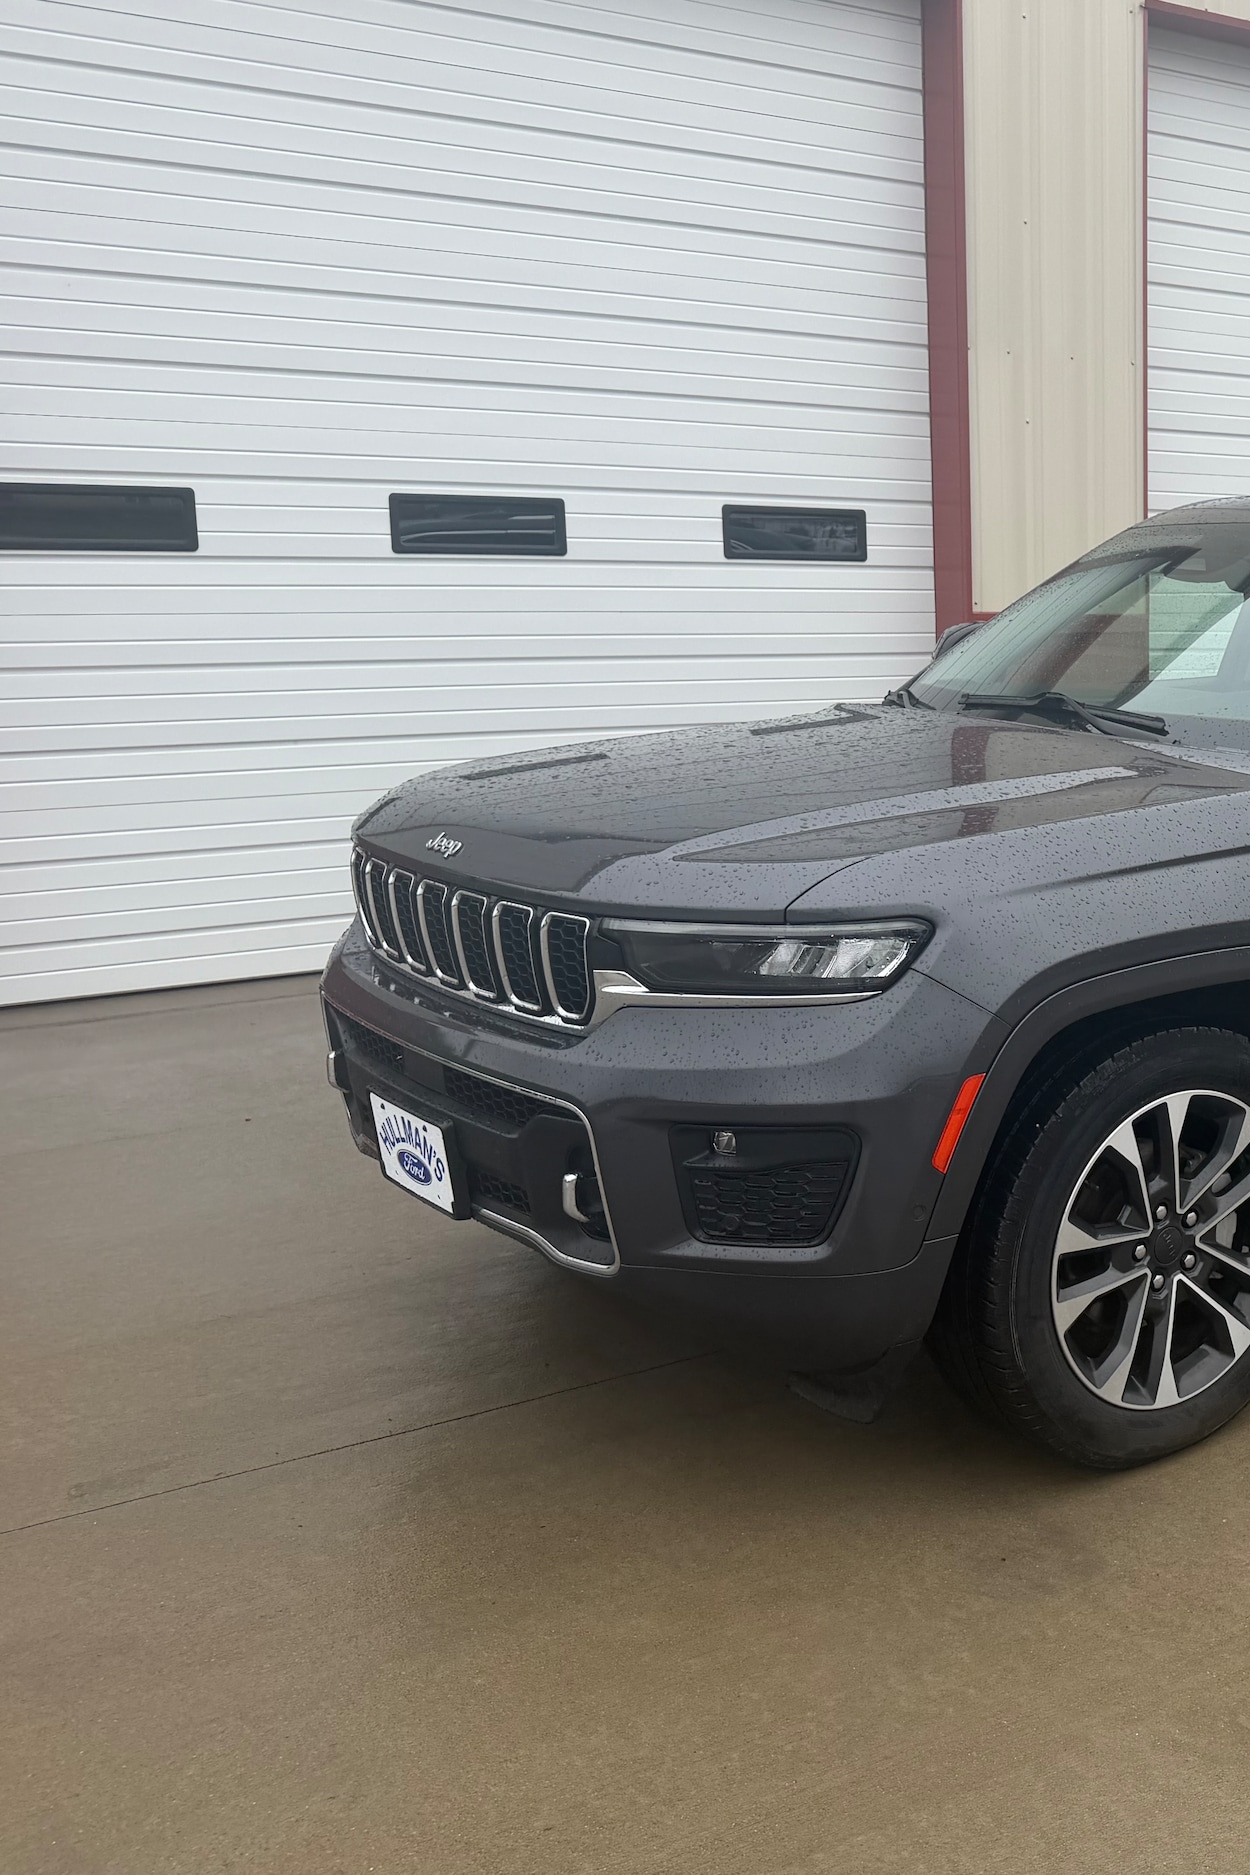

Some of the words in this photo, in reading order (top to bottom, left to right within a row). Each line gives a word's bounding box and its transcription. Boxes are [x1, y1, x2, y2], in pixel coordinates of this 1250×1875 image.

[425, 831, 462, 858] Jeep
[379, 1114, 445, 1182] HULLMAN'S
[403, 1152, 426, 1181] Ford
